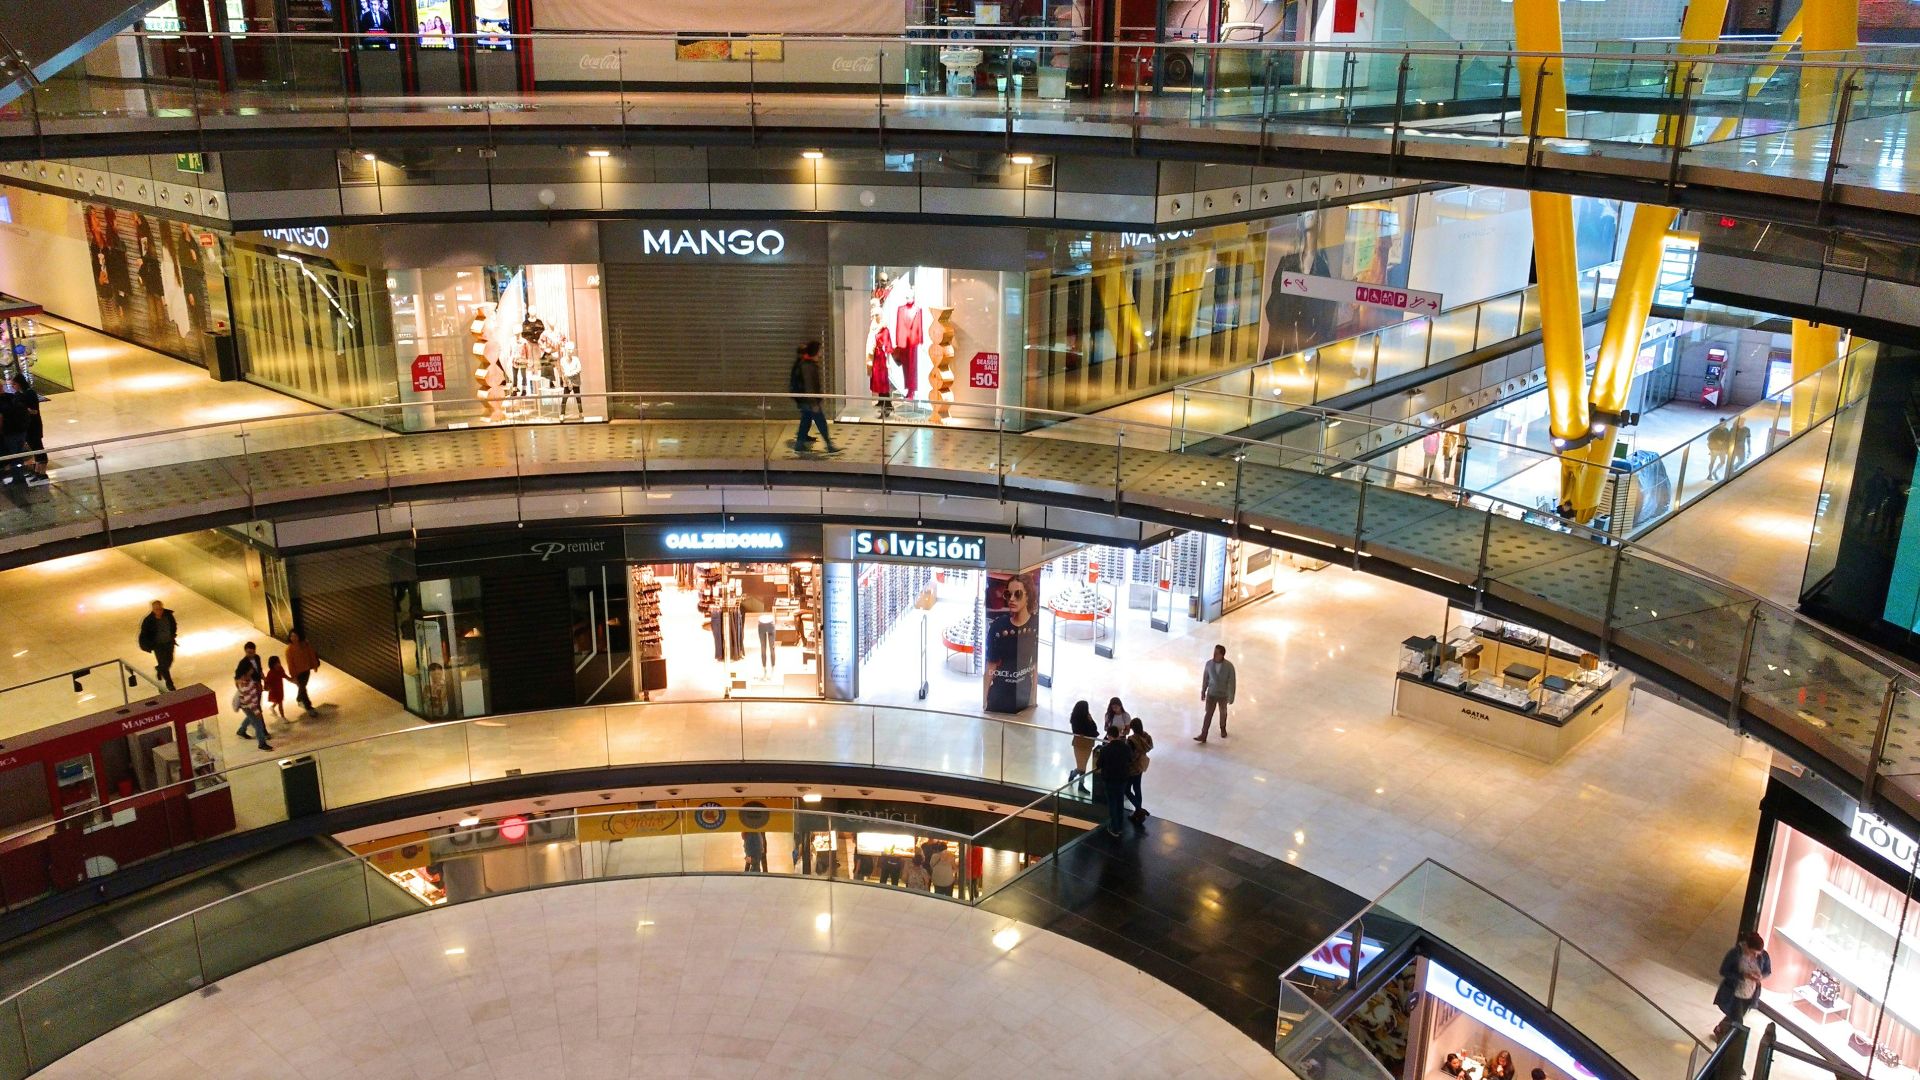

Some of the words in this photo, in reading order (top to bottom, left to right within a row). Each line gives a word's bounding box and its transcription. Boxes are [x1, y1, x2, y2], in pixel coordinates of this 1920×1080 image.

[643, 229, 785, 255] MANGO
[530, 539, 605, 561] Premier
[665, 532, 784, 549] CALZEDONIA
[857, 532, 981, 560] Solvisión
[988, 669, 1009, 677] DOLCE
[1461, 707, 1490, 721] AGATHA
[449, 813, 552, 847] UDON
